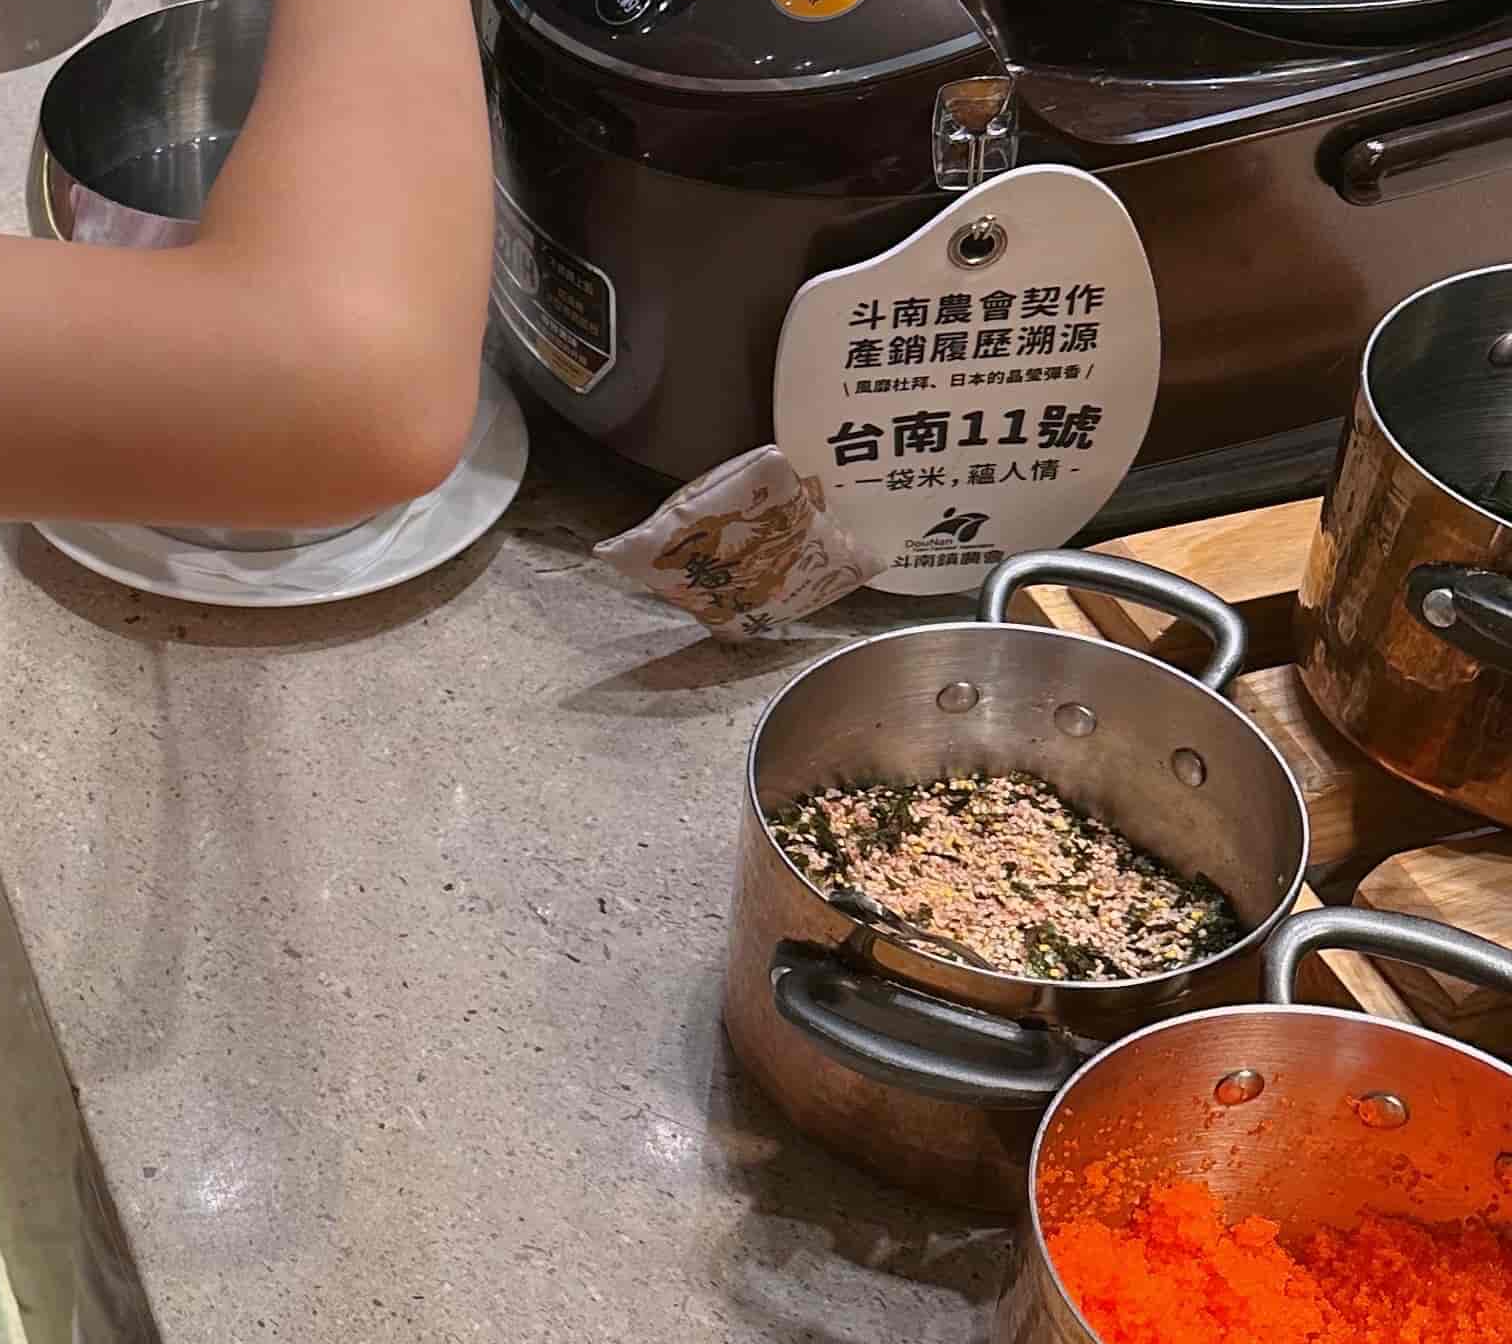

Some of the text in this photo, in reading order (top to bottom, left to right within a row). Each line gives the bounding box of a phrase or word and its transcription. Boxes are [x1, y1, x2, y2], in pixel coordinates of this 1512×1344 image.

[847, 283, 1105, 331] 斗南農會契作
[844, 321, 1101, 370] 產銷履歷溯源
[826, 403, 1103, 467] 台南11號
